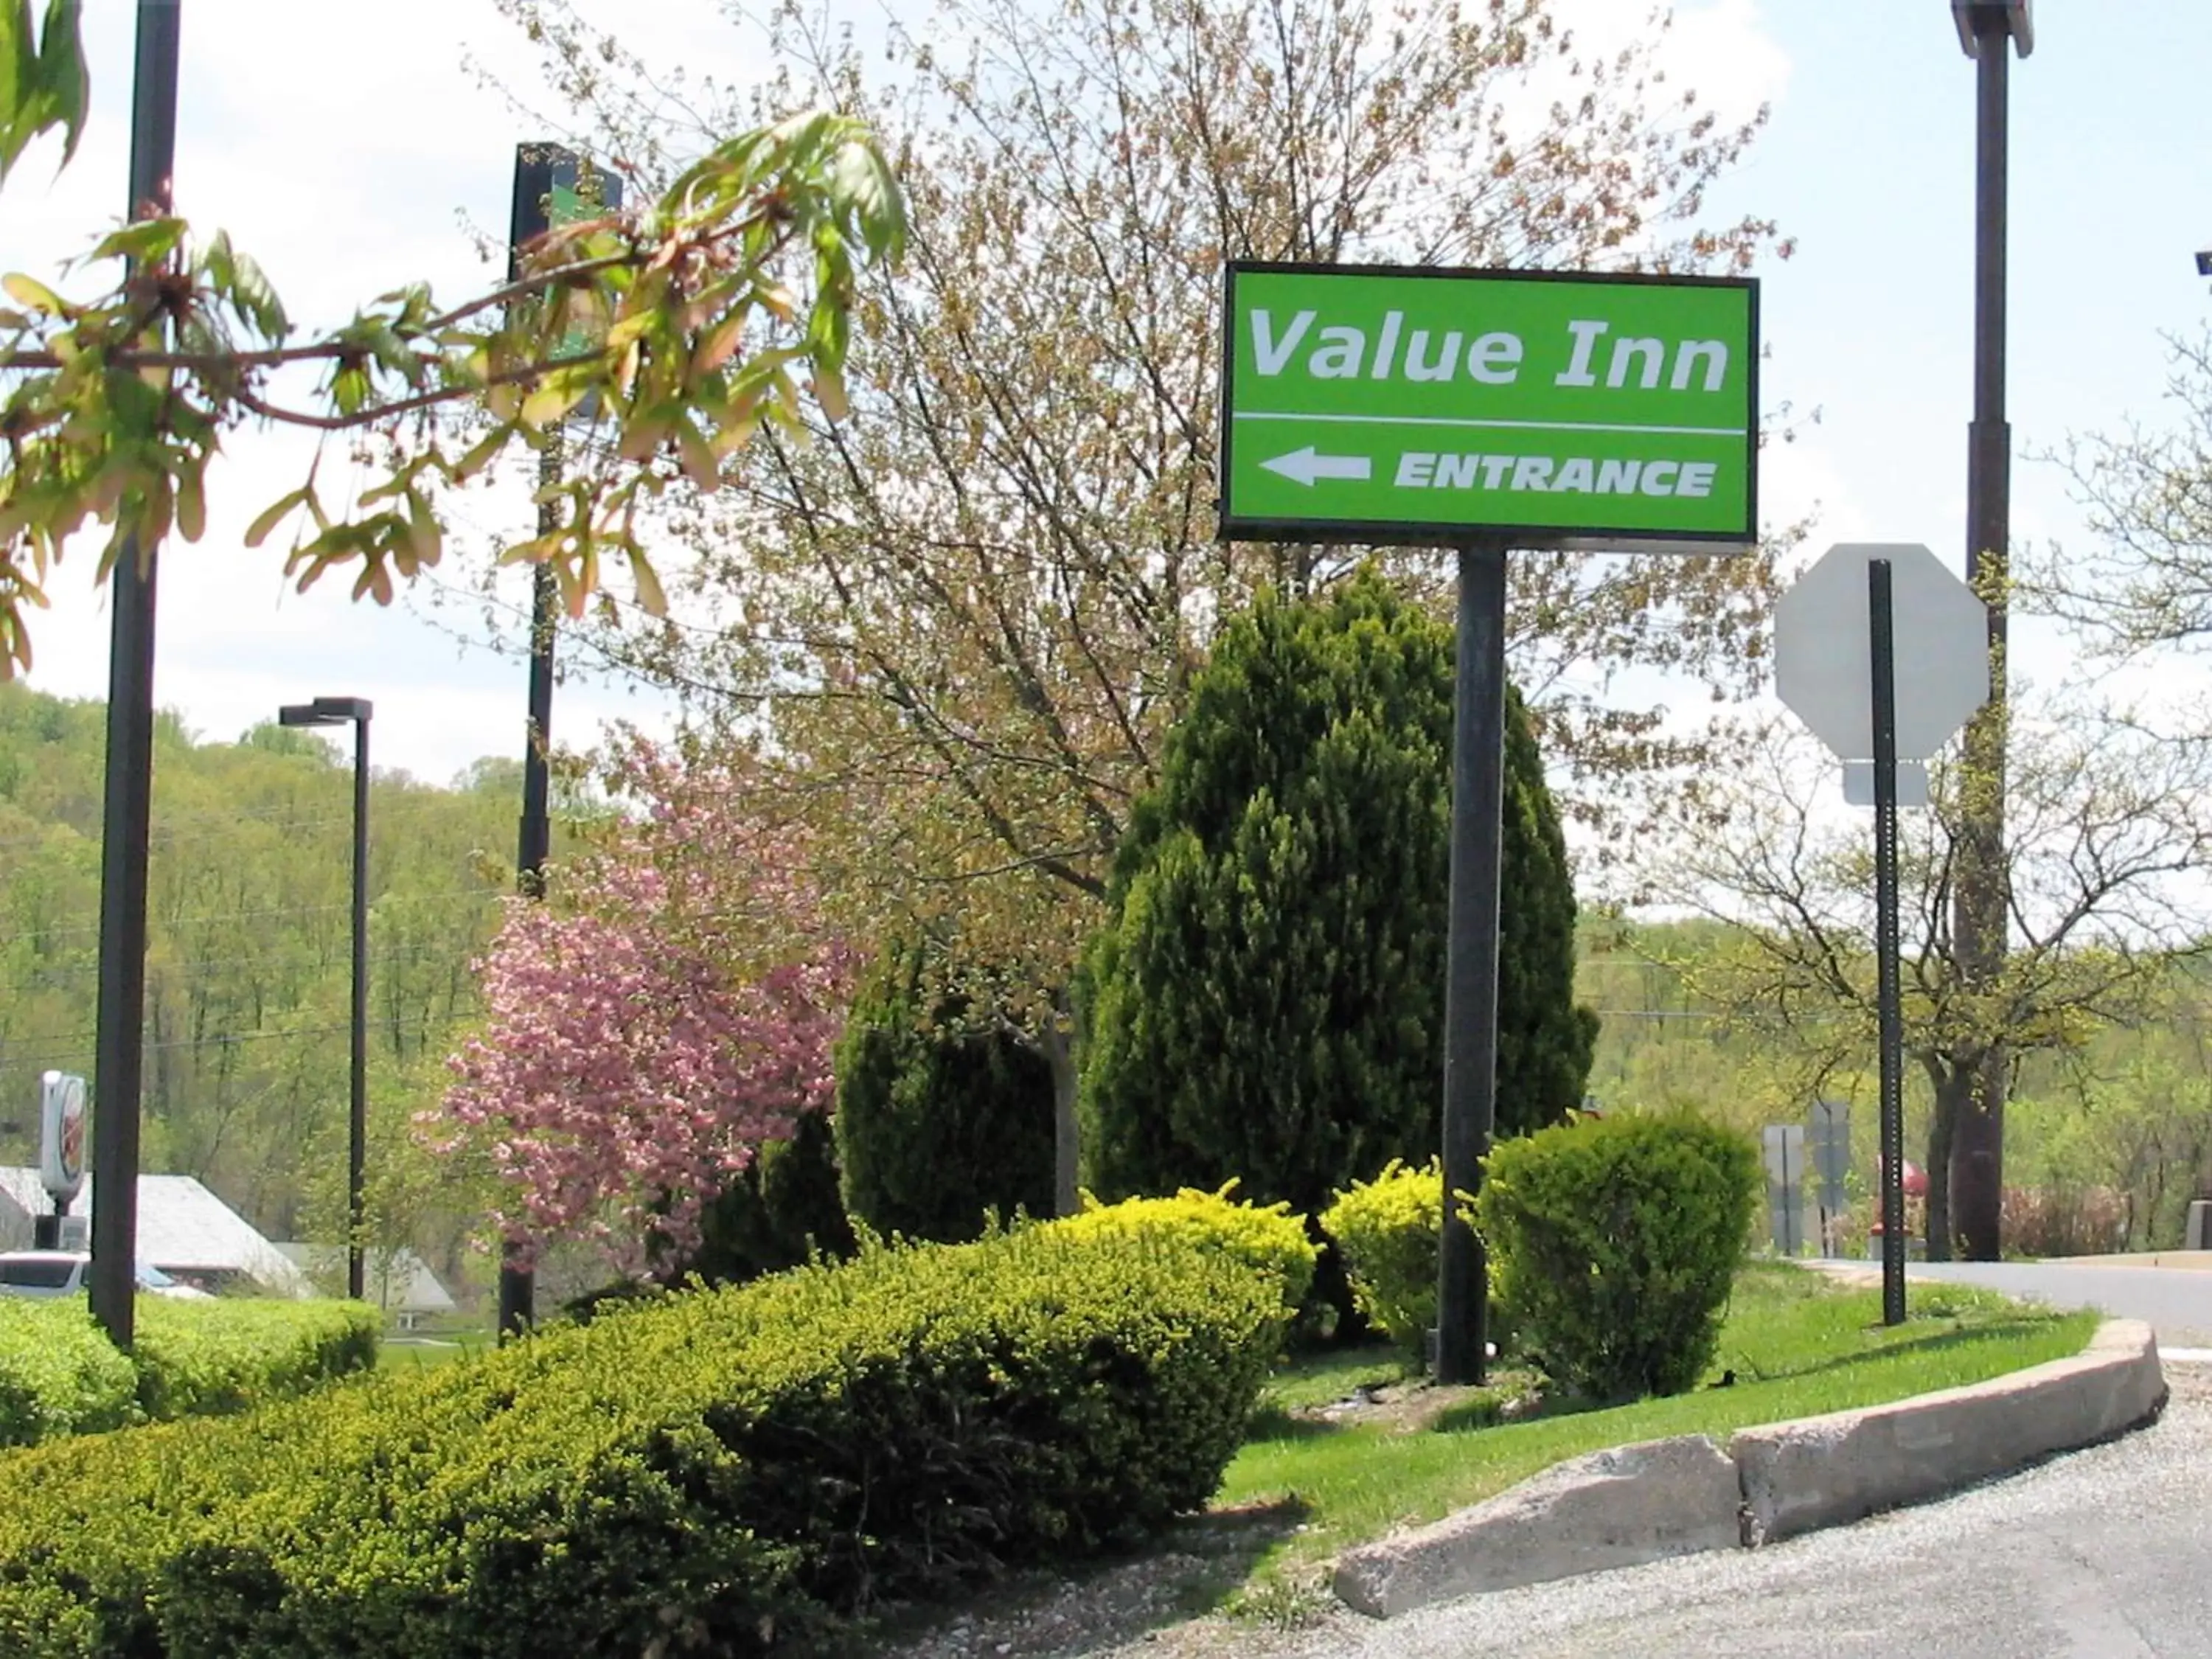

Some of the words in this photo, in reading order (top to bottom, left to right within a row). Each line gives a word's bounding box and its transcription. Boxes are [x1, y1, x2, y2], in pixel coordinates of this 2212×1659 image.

[1250, 309, 1524, 385] Value
[1554, 319, 1728, 392] Inn
[1394, 452, 1717, 498] ENTRANCE
